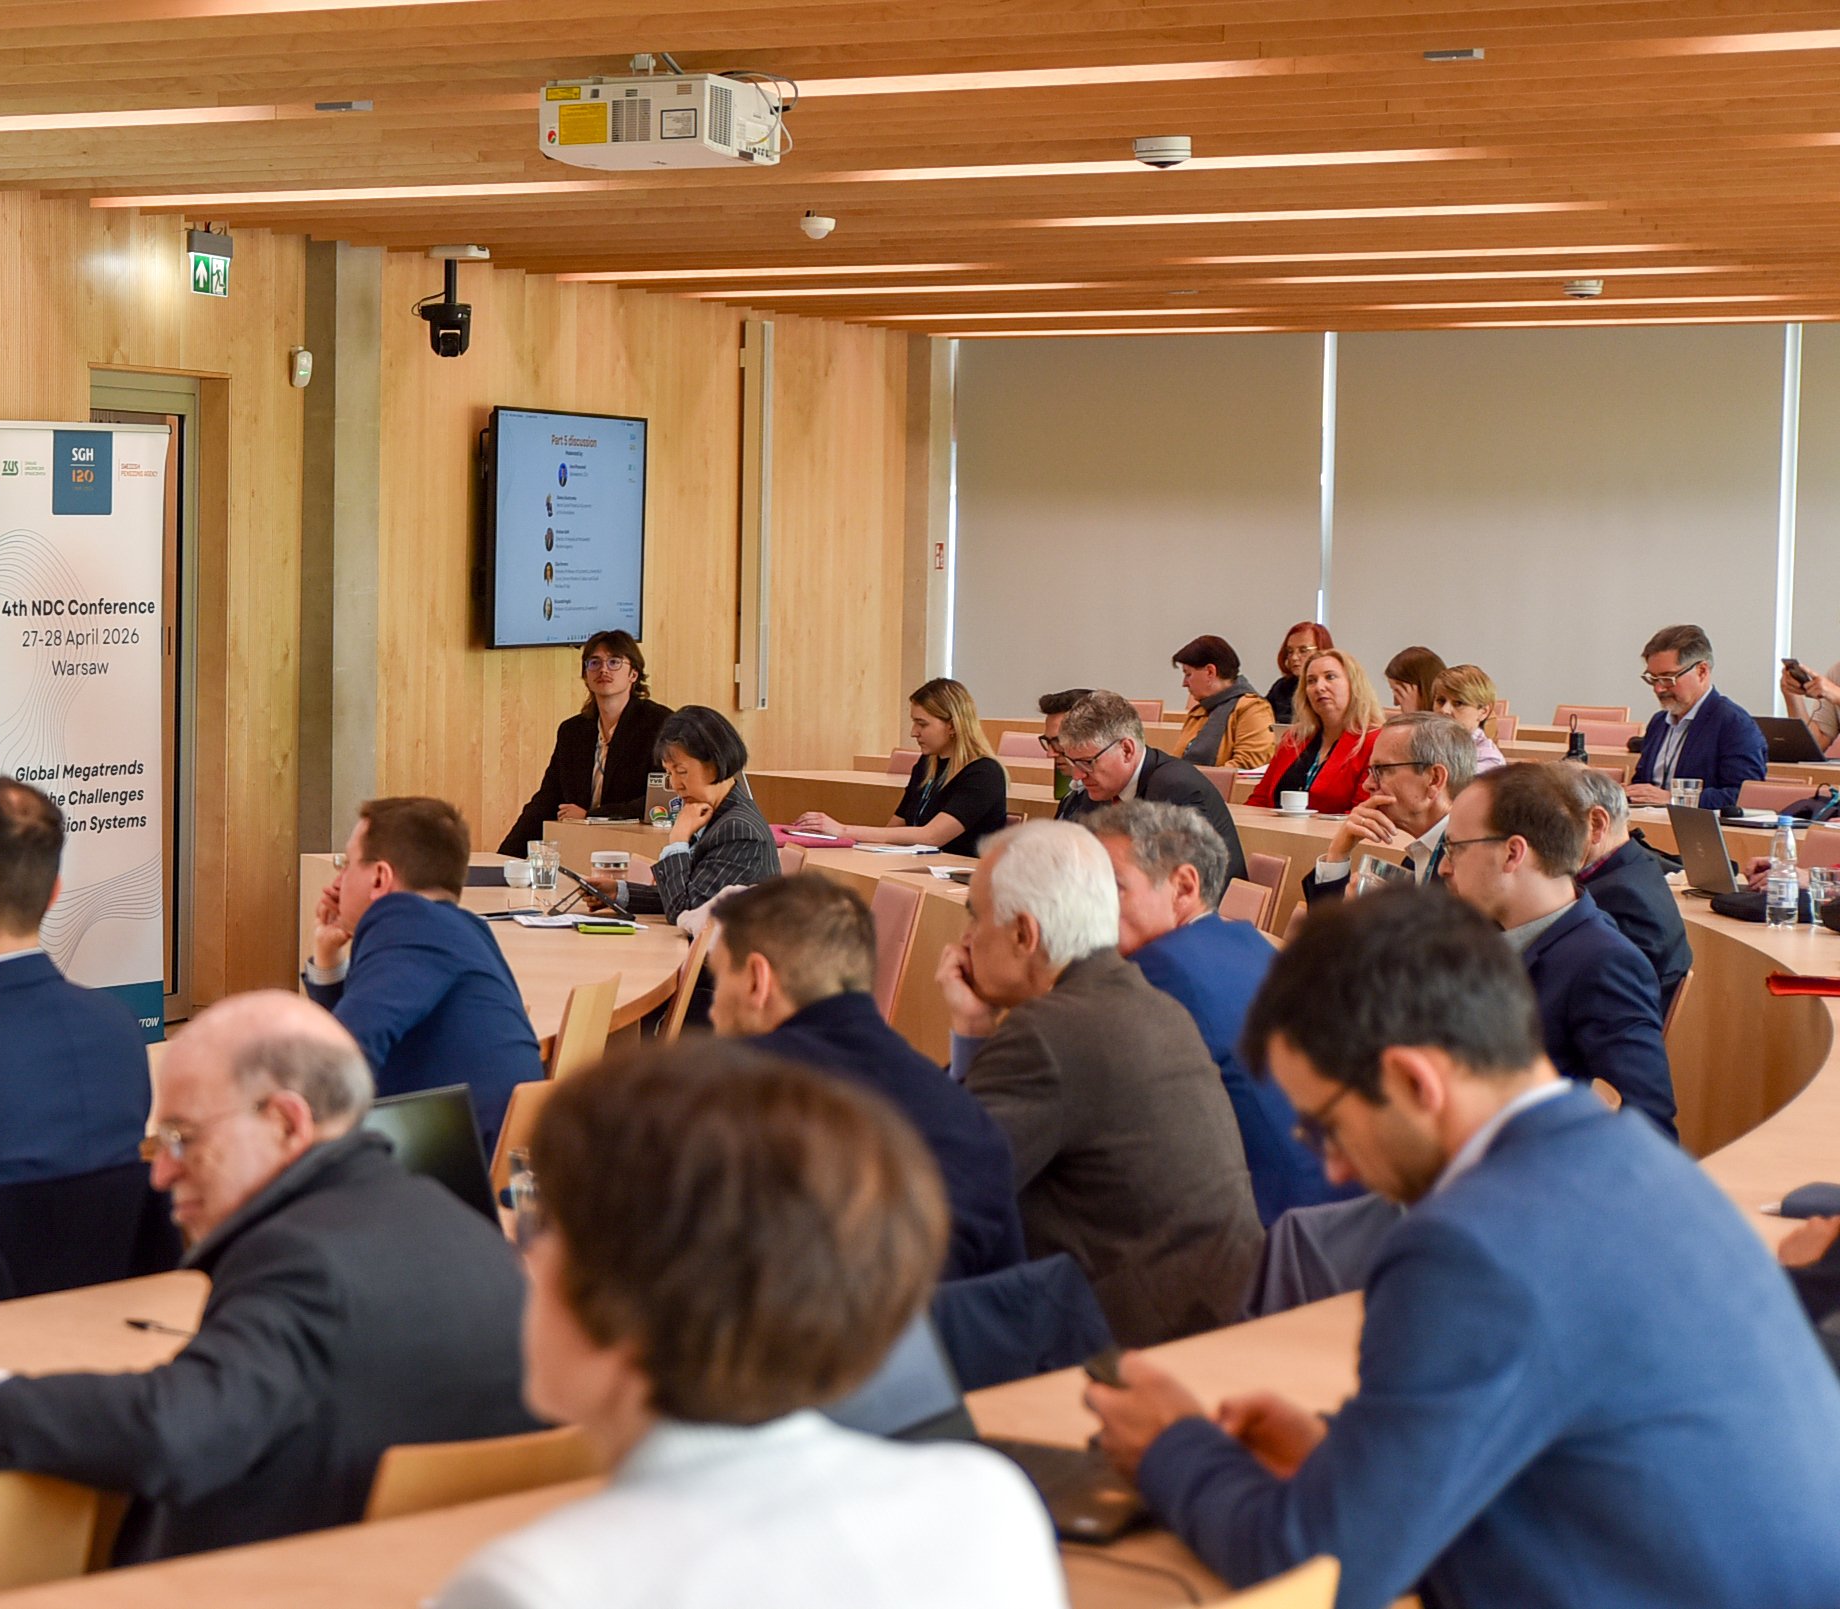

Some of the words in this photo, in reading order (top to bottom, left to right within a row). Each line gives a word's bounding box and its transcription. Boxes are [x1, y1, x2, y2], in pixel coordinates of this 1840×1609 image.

[568, 435, 597, 448] discussion
[72, 448, 94, 461] SGH
[2, 460, 19, 476] ZUS
[72, 470, 94, 483] 120
[1, 600, 27, 616] 4th
[32, 600, 65, 616] NDC
[68, 598, 155, 615] Conference
[22, 630, 62, 647] 27-28
[65, 628, 98, 649] April
[102, 628, 139, 645] 2026
[51, 660, 109, 676] Warsaw
[15, 764, 60, 782] Global
[62, 760, 144, 781] Megatrends
[49, 791, 66, 806] he
[68, 788, 144, 806] Challenges
[90, 815, 147, 833] Systems
